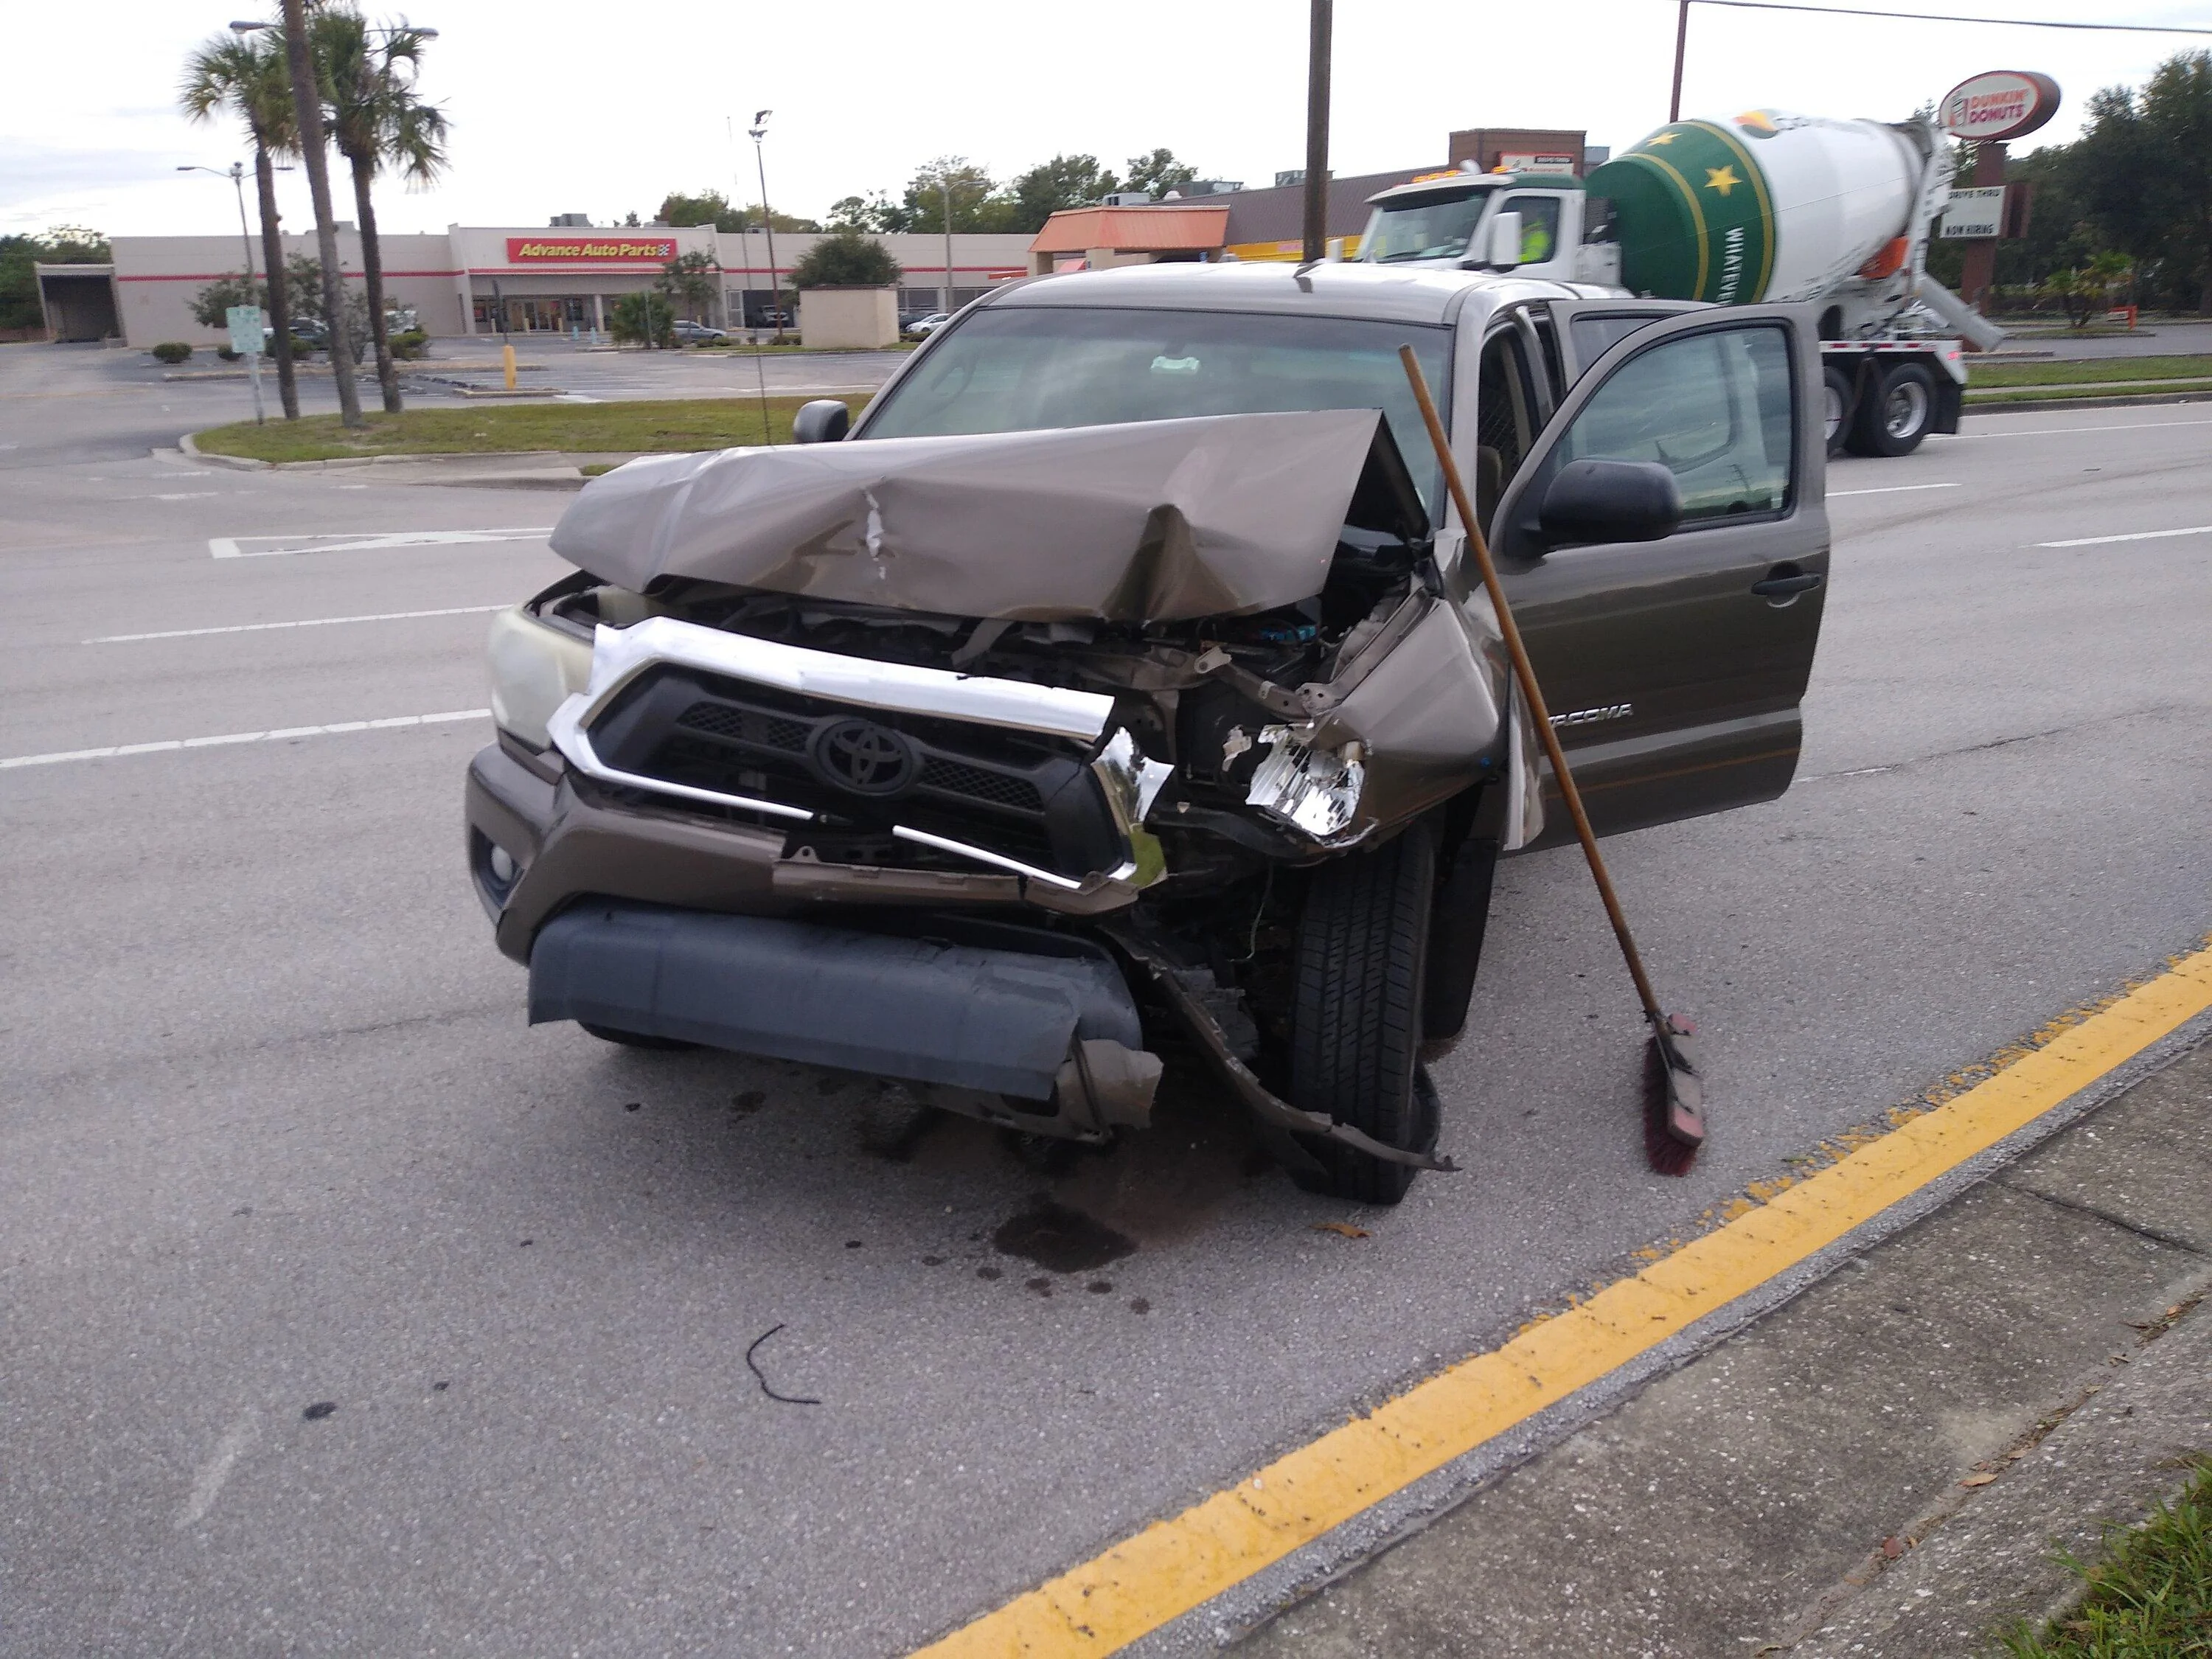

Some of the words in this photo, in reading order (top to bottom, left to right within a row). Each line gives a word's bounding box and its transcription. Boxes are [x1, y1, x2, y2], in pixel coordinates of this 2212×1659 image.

[1969, 104, 2024, 124] DONUTS
[518, 243, 580, 257] Advance
[580, 243, 618, 257] Auto
[618, 243, 658, 257] Parts
[1548, 703, 1634, 729] ACOMA
